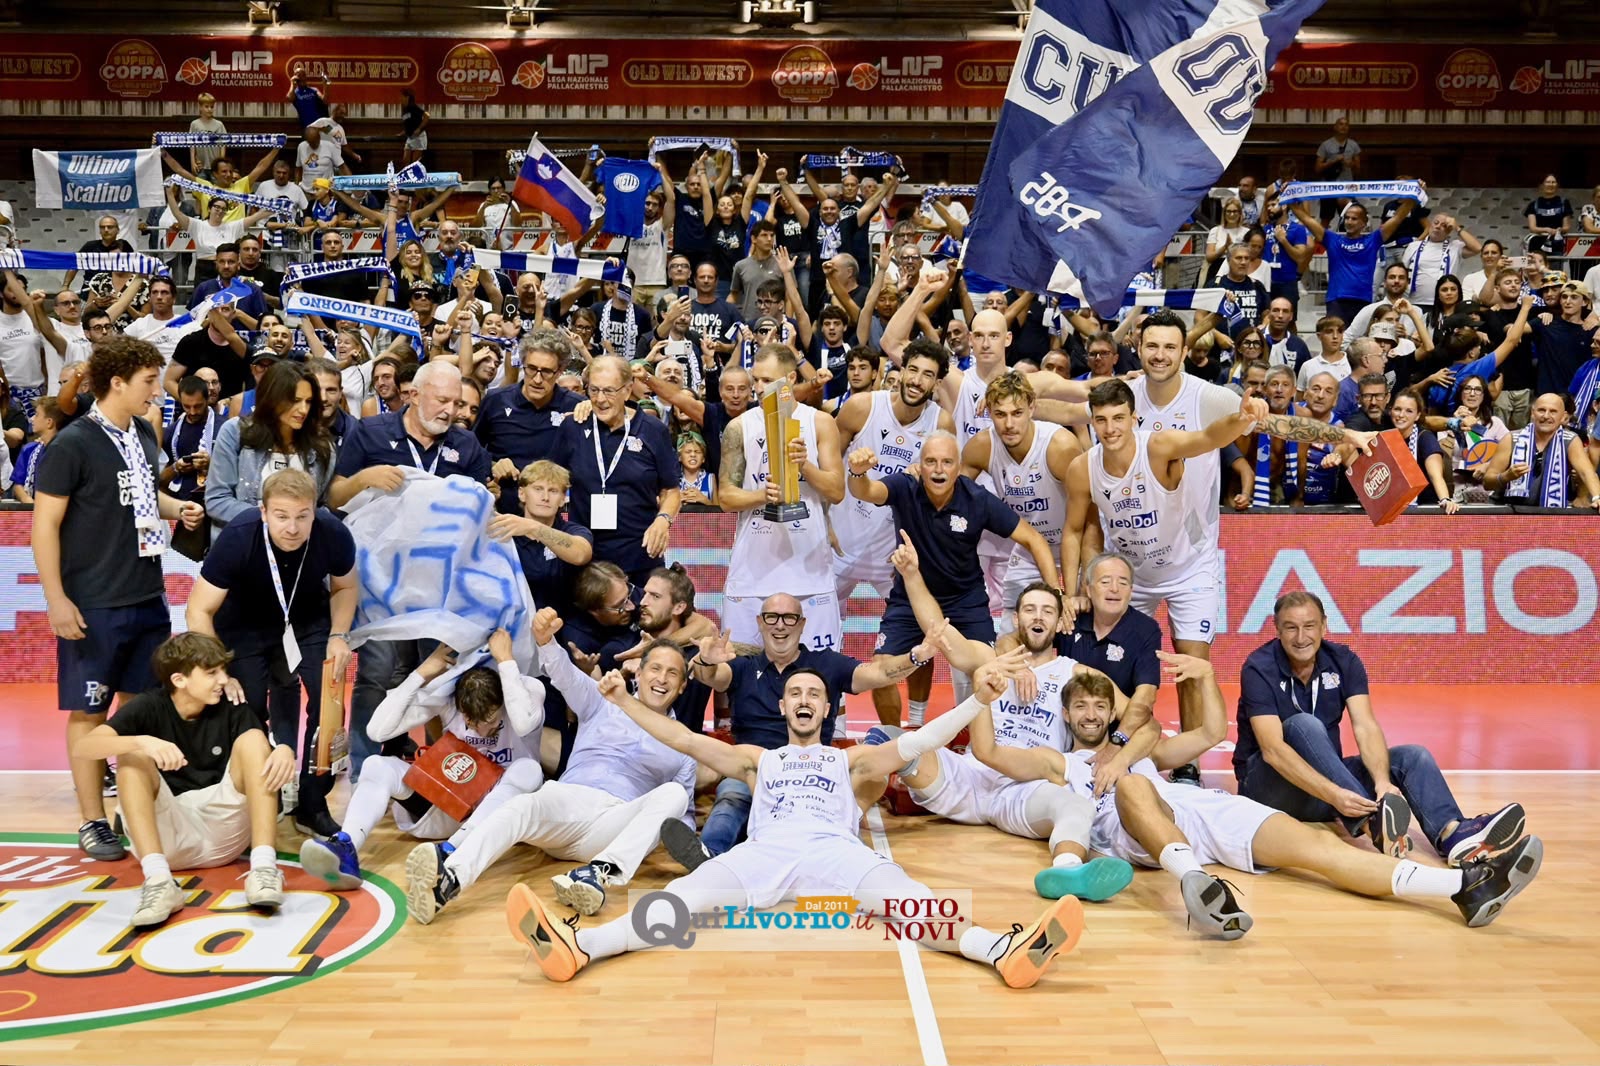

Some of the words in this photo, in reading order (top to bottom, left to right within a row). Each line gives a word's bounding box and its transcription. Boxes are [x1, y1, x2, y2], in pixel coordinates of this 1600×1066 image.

[0, 58, 27, 74] ILD
[30, 58, 74, 74] WEST
[114, 56, 155, 65] SUPER
[211, 51, 273, 71] LNP
[451, 59, 491, 69] SUPER
[547, 54, 609, 75] LNP
[785, 62, 825, 71] SUPER
[881, 56, 943, 76] LNP
[102, 65, 165, 79] COPPA
[327, 62, 366, 79] WILD
[368, 62, 412, 79] WEST
[440, 69, 501, 83] COPPA
[629, 64, 660, 81] OLD
[662, 64, 701, 81] WILD
[703, 64, 746, 81] WEST
[963, 65, 992, 81] OLD
[1295, 68, 1326, 84] OLD
[1328, 68, 1366, 84] WILD
[1368, 68, 1411, 84] WEST
[1544, 60, 1600, 79] LNP
[774, 71, 836, 85] COPPA
[1438, 75, 1499, 88] COPPA
[161, 136, 210, 144] REBELS
[67, 155, 130, 174] Ultimo
[64, 182, 132, 203] Scalino
[1304, 184, 1344, 193] PIELLINO
[299, 297, 366, 316] LIVORNO
[690, 313, 722, 326] 100%
[915, 441, 922, 450] 4
[880, 444, 913, 462] PIELLE
[1029, 473, 1041, 483] 15
[1364, 466, 1389, 497] Beretta
[1005, 485, 1035, 496] PIELLE
[1137, 484, 1146, 494] 9
[1200, 620, 1210, 633] 9
[813, 634, 834, 648] 11
[1043, 682, 1058, 693] 33
[1018, 724, 1051, 741] DATALITE
[819, 754, 836, 763] 10
[445, 756, 474, 781] Beretta
[766, 774, 836, 793] VeroDol
